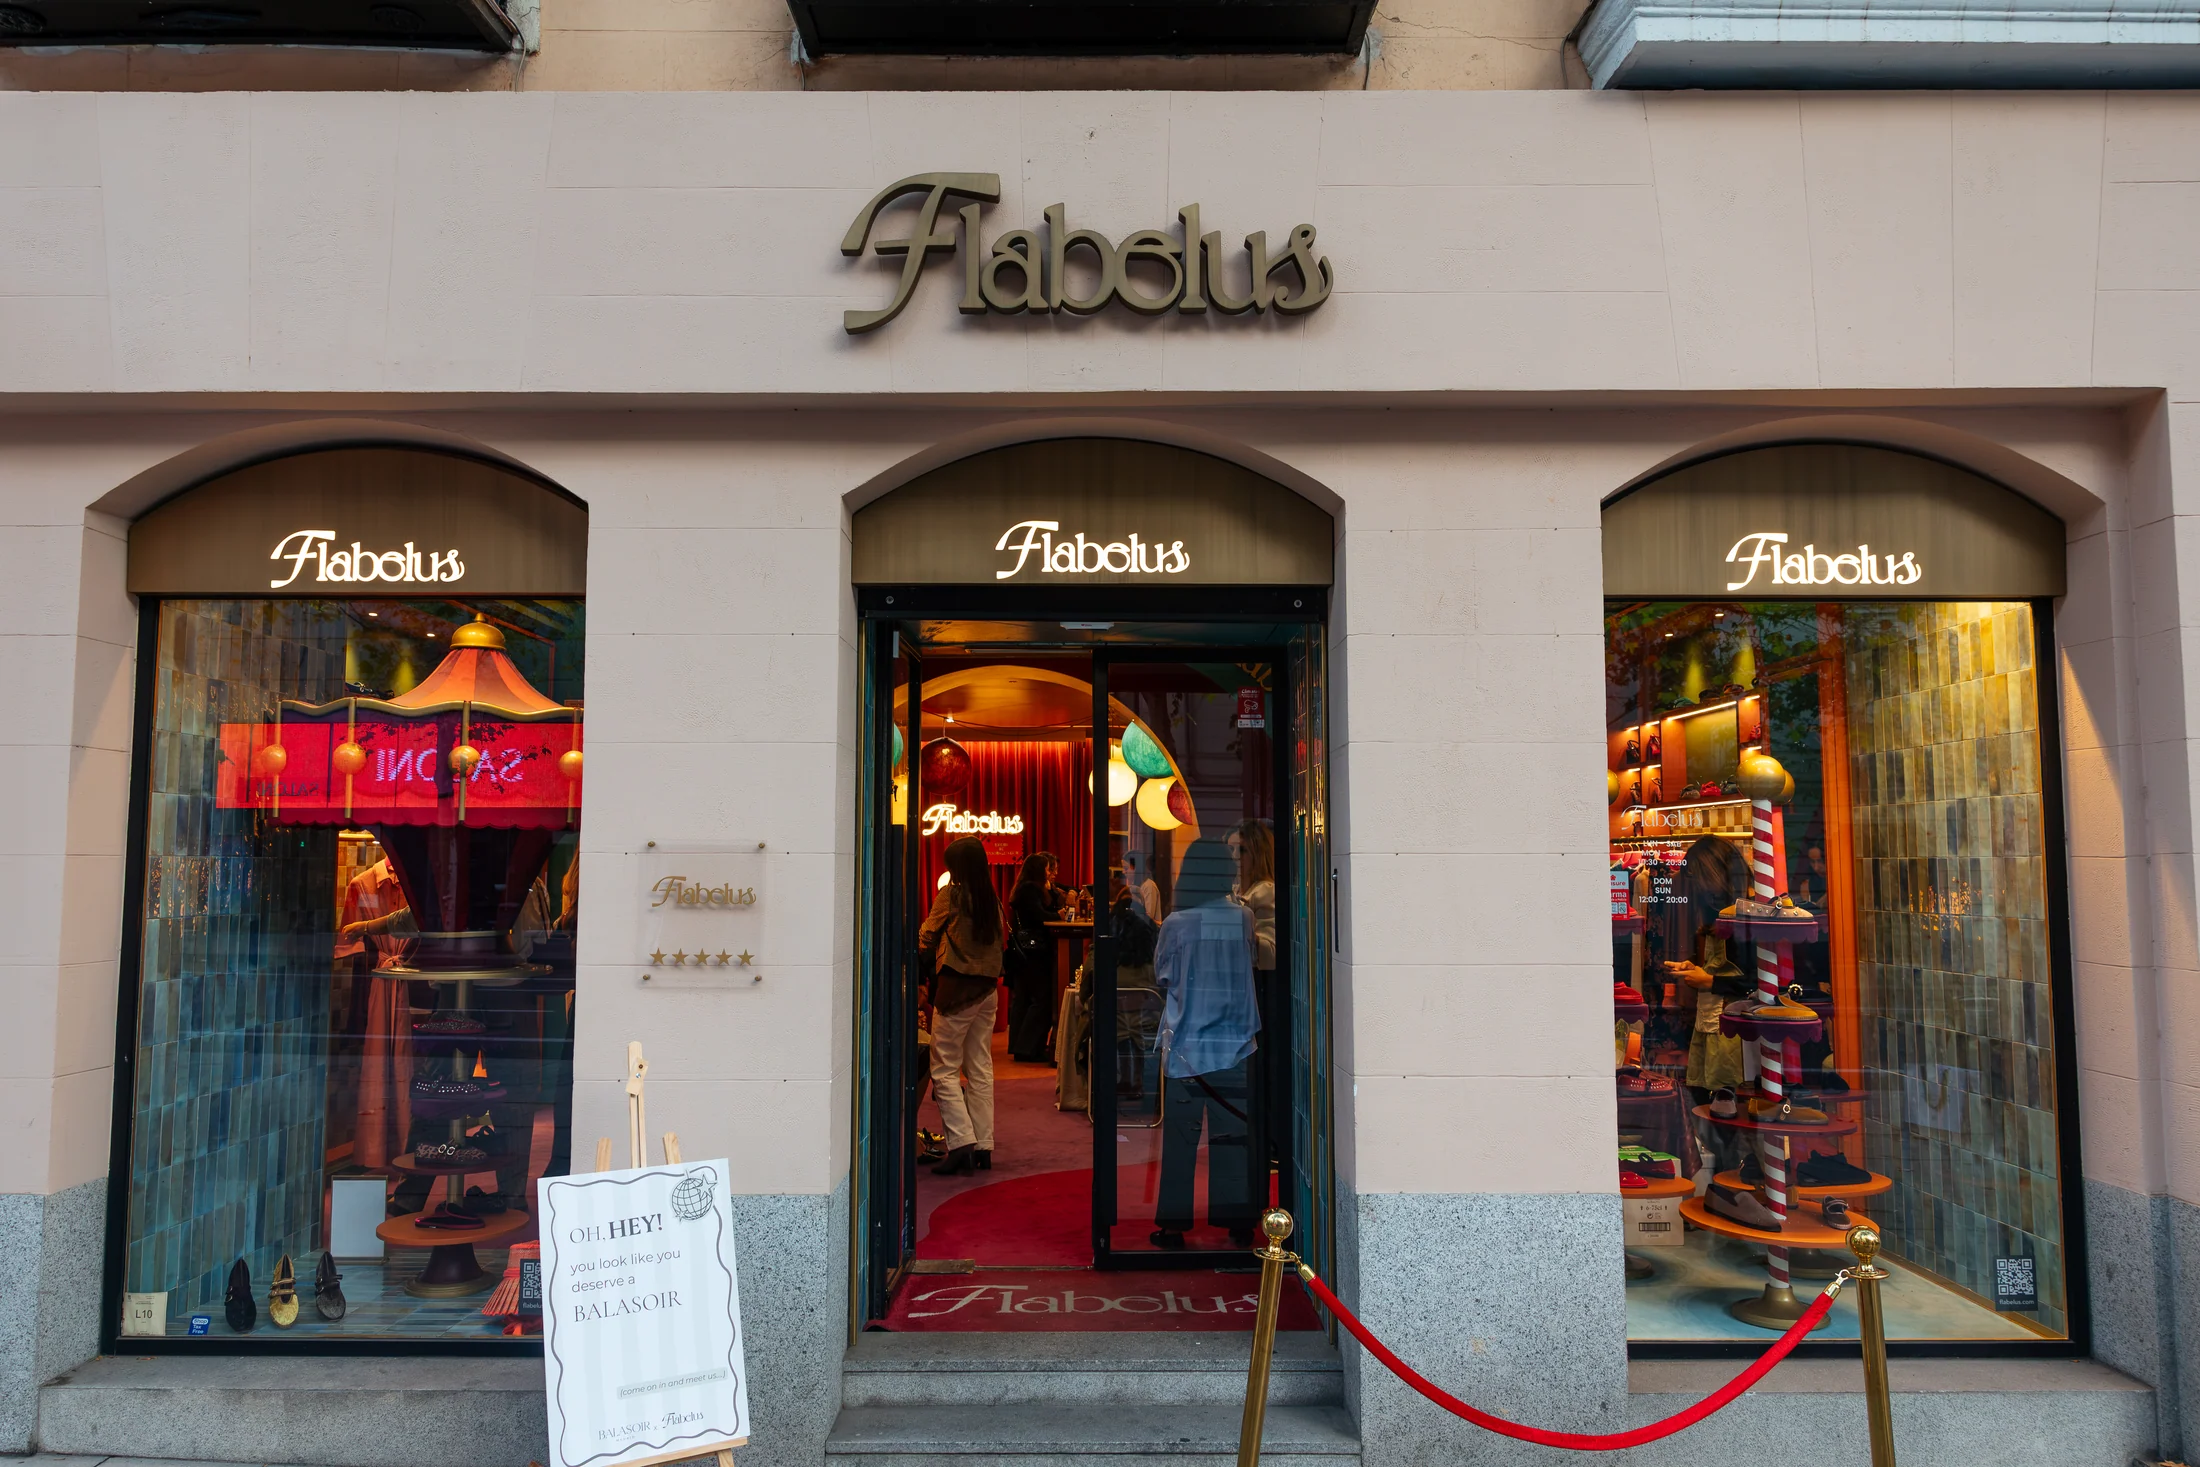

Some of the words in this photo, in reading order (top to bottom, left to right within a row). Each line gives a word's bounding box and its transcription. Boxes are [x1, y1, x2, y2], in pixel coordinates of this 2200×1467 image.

[841, 172, 1334, 335] Flabelus
[270, 529, 465, 589] Flabelus
[995, 520, 1191, 580] Flabelus
[1725, 532, 1922, 591] Flabelus
[922, 803, 1024, 836] Flabelus
[1620, 805, 1703, 830] Flabelus
[651, 875, 757, 908] Flabelus
[1666, 896, 1688, 904] 20:00
[569, 1225, 606, 1244] OH,
[608, 1213, 662, 1240] HEY!
[570, 1262, 595, 1276] you
[599, 1255, 628, 1269] look
[631, 1252, 653, 1265] like
[657, 1250, 681, 1264] you
[571, 1277, 625, 1293] deserve
[628, 1275, 635, 1285] a
[135, 1309, 153, 1319] L10
[574, 1290, 682, 1323] BALASOIR
[620, 1385, 645, 1398] (come
[646, 1384, 657, 1392] on
[659, 1381, 667, 1389] in
[668, 1378, 684, 1388] and
[685, 1374, 706, 1384] meet
[598, 1421, 651, 1441] BALASOIR
[661, 1411, 704, 1429] Flabelus
